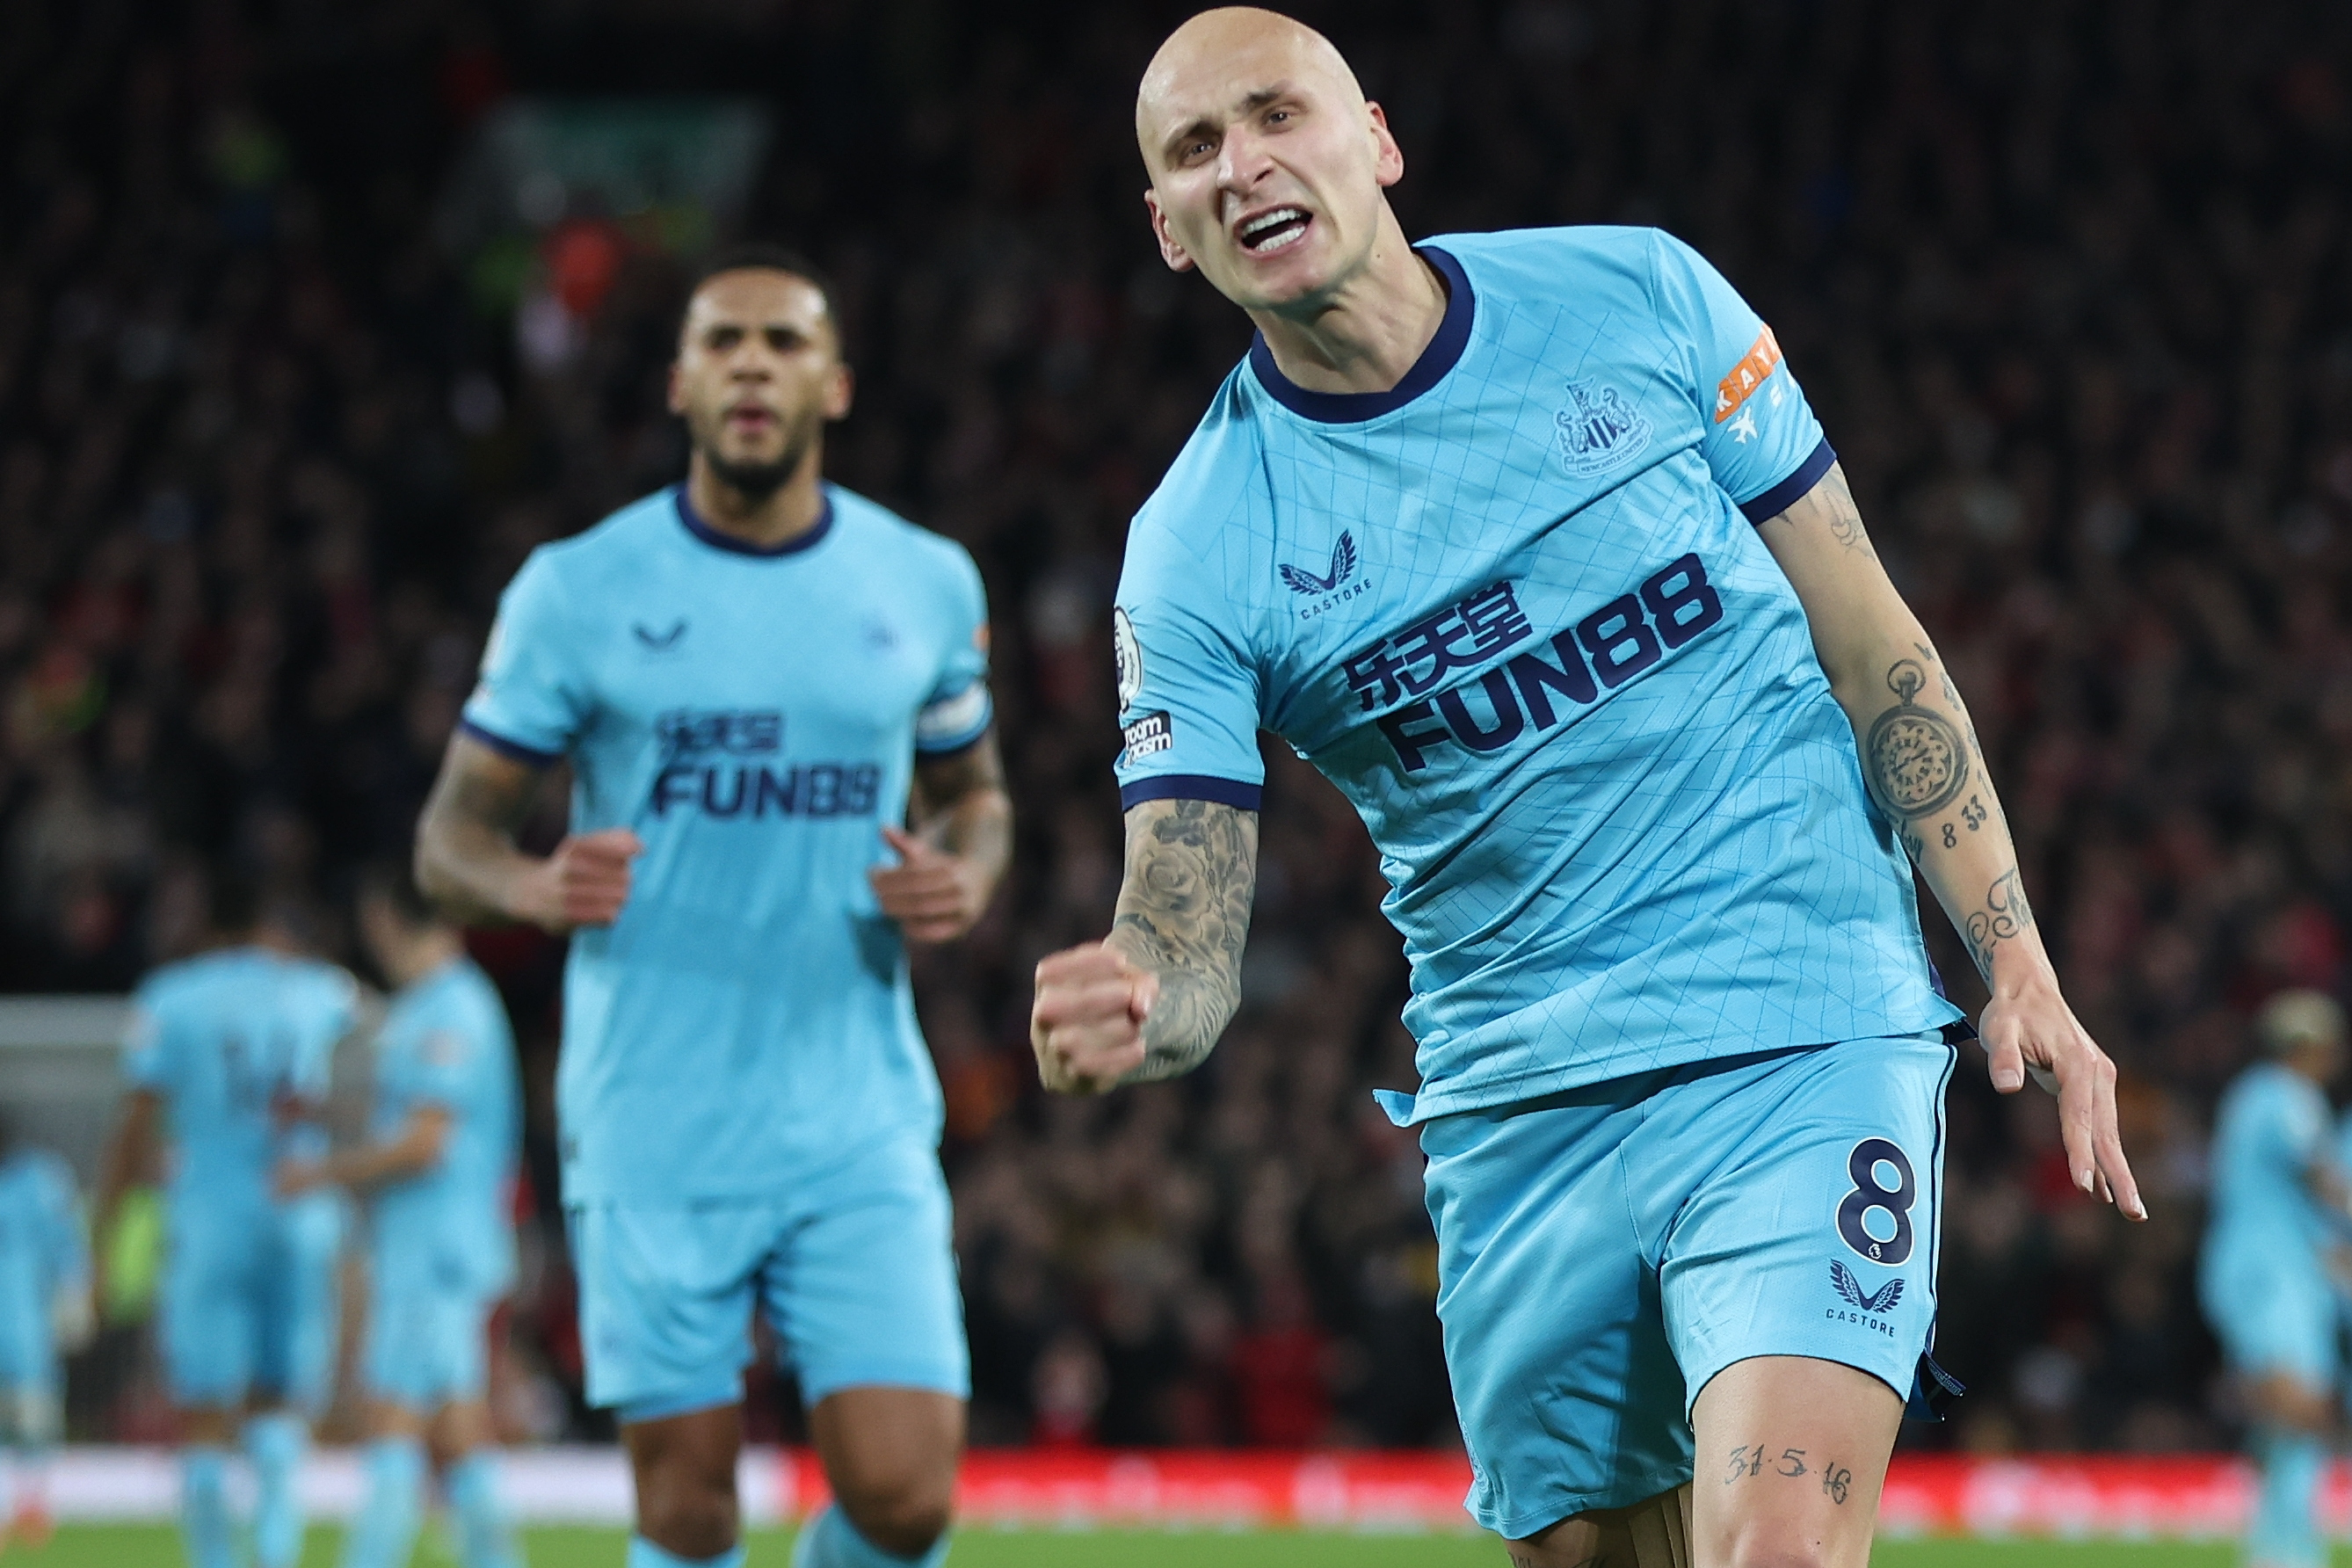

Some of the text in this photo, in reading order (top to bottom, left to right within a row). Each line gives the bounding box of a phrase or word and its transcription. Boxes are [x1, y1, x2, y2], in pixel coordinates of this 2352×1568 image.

[1301, 577, 1372, 621] CASTORE
[1340, 580, 1534, 713] 乐天堂
[1376, 552, 1724, 773] FUN88
[1124, 715, 1162, 749] room
[1835, 1136, 1917, 1267] 8
[1826, 1308, 1895, 1338] CASTORE
